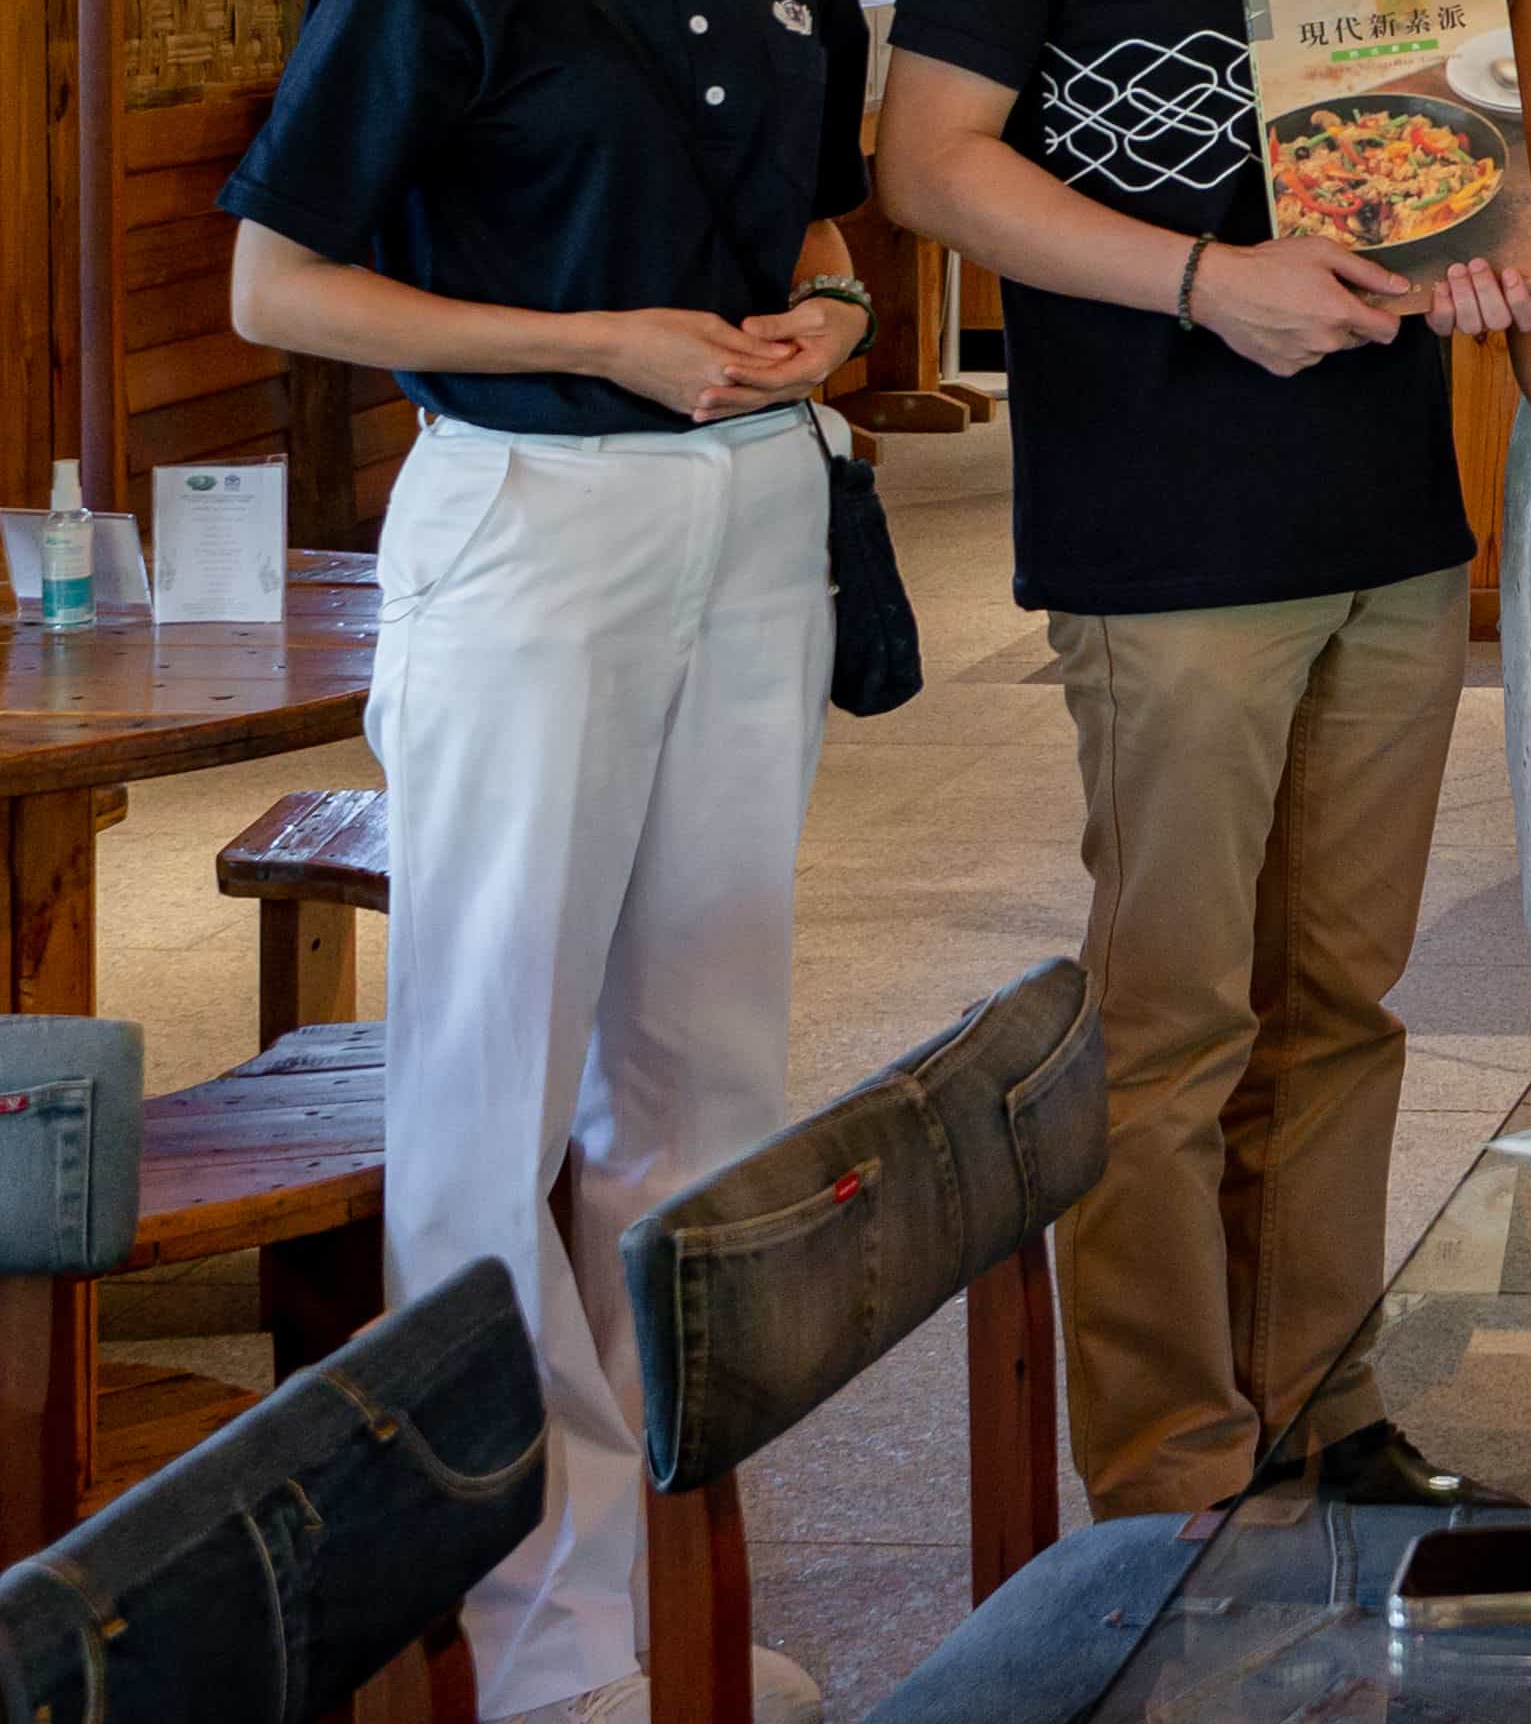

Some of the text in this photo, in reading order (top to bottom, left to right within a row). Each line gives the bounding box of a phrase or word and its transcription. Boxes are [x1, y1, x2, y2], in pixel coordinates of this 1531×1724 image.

[1299, 4, 1468, 48] 現代新素派
